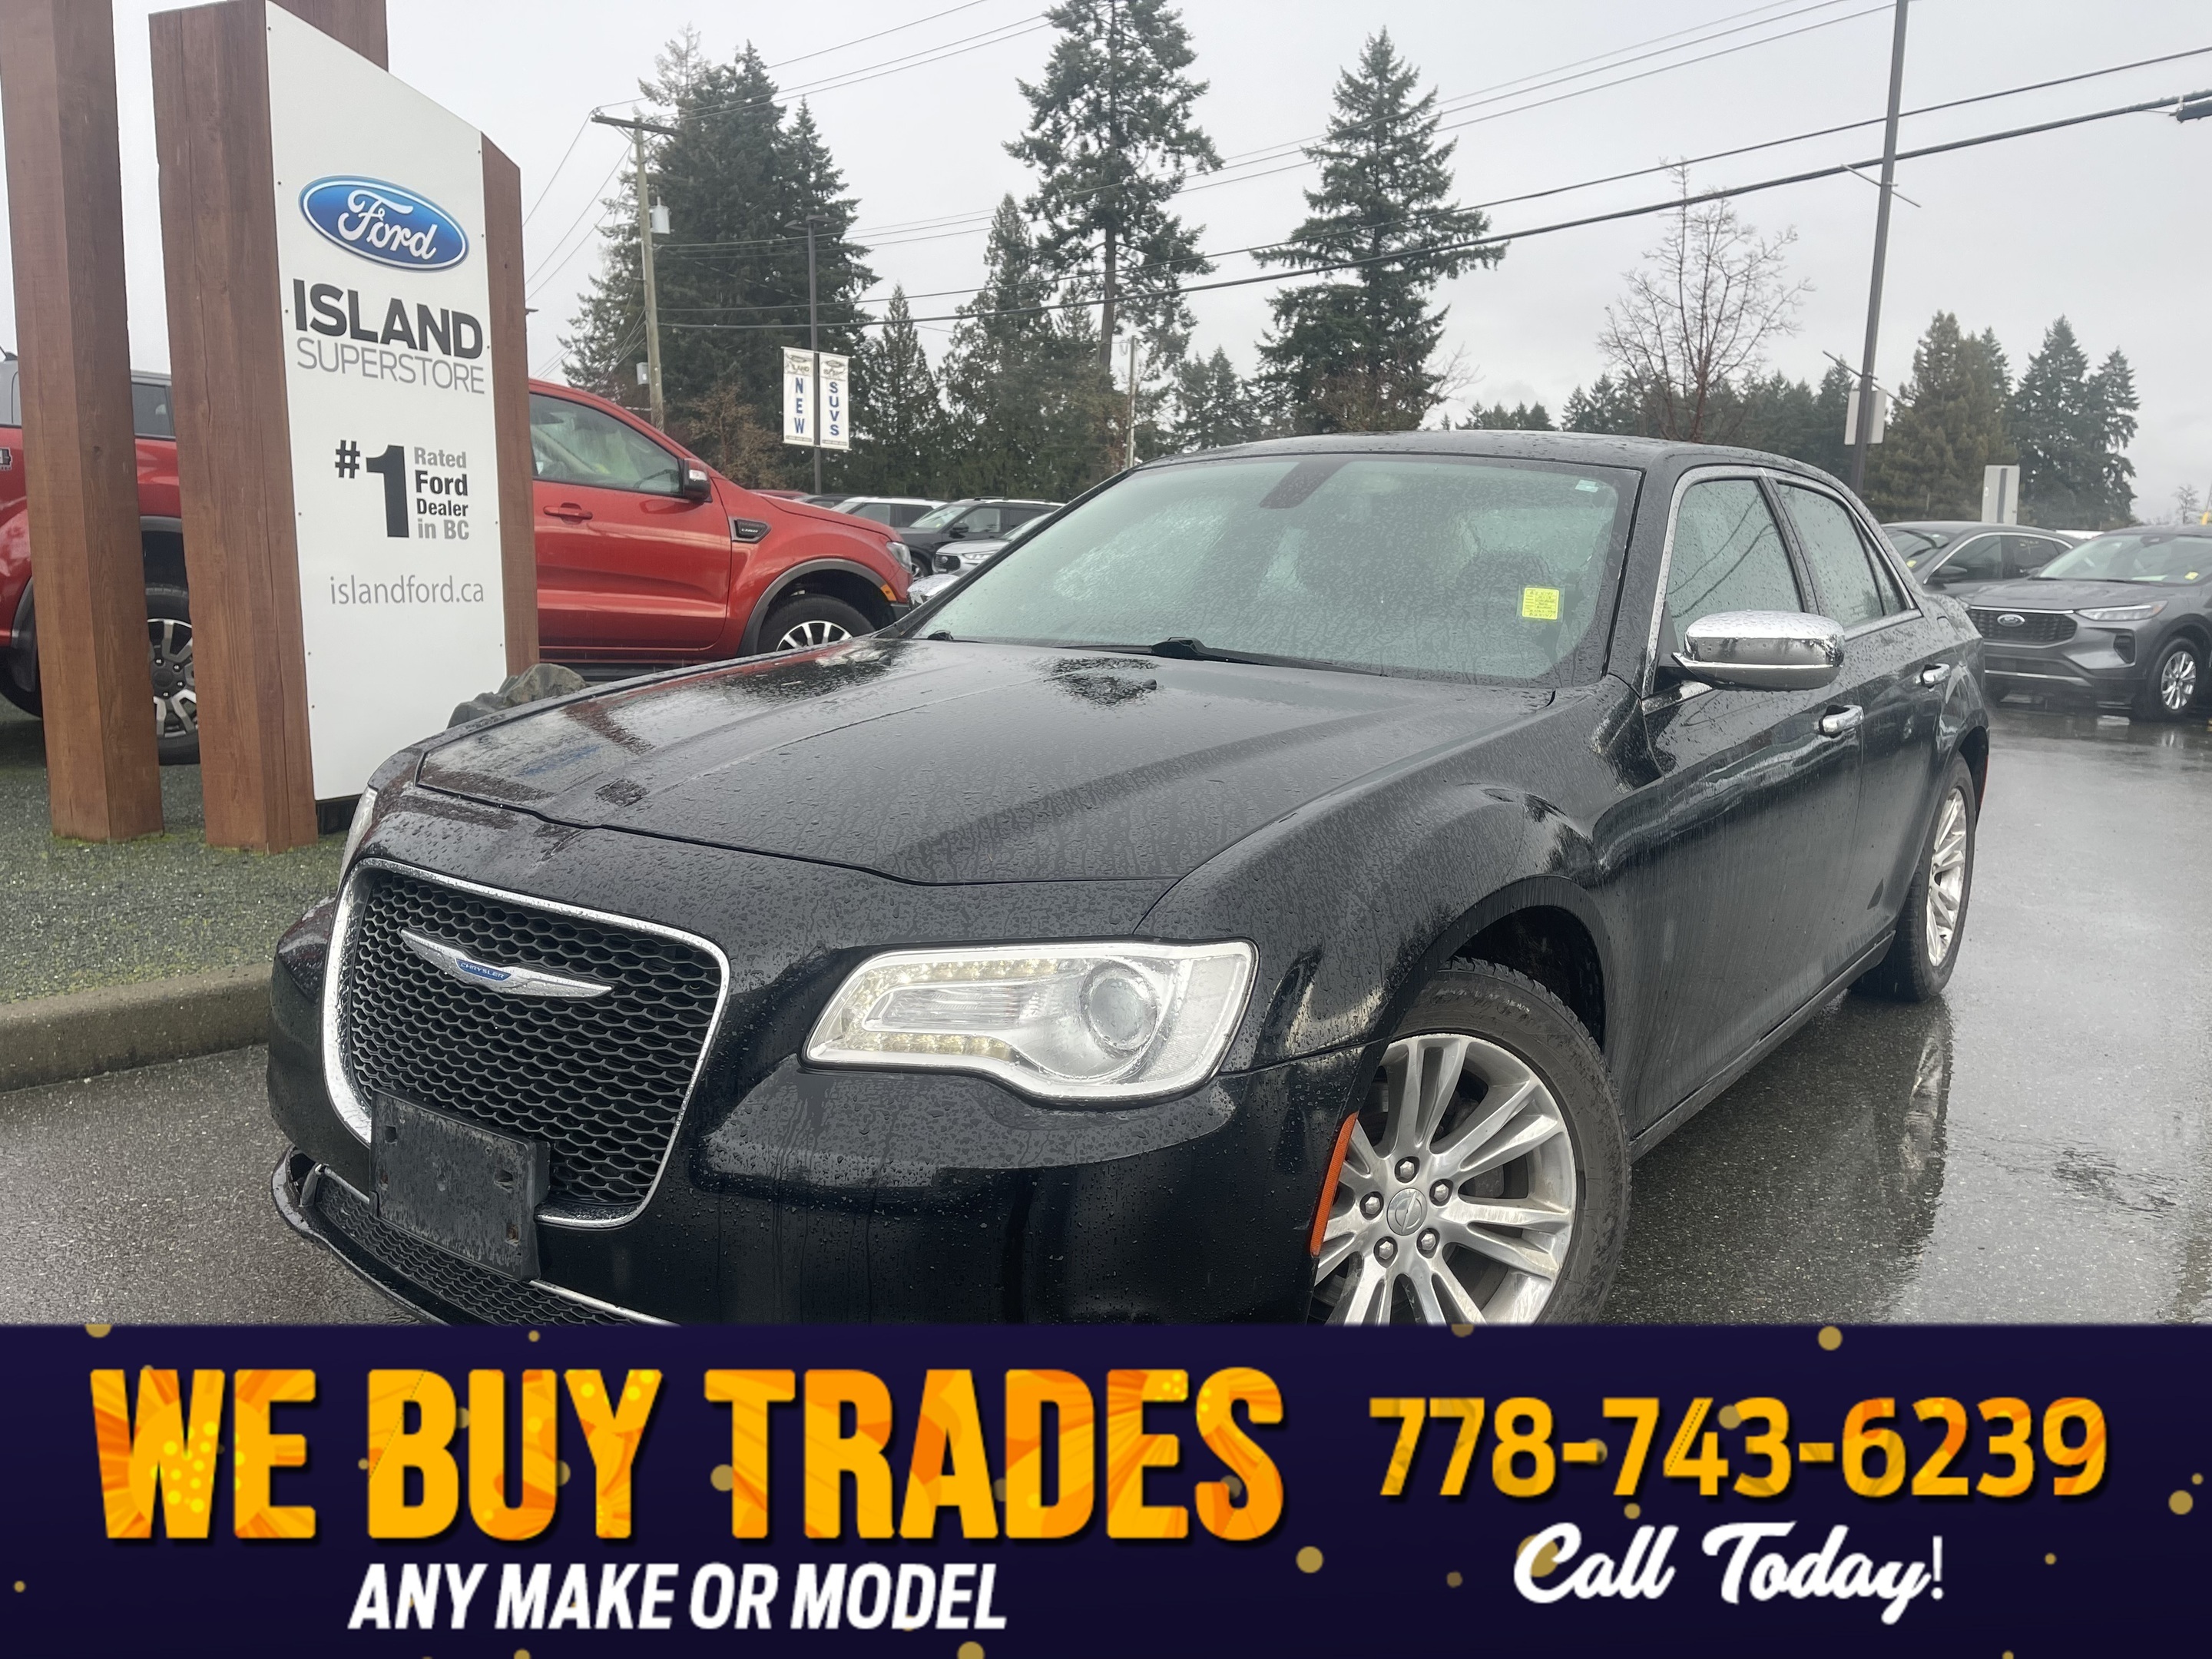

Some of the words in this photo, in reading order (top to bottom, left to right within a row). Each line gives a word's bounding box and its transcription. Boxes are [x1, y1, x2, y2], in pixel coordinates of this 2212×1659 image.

[338, 189, 437, 260] Ford
[293, 278, 483, 359] ISLAND
[296, 336, 485, 394] SUPERSTORE
[794, 377, 805, 435] NEW
[829, 381, 839, 436] SUVS
[413, 446, 467, 469] Rated
[335, 439, 409, 538] #1
[415, 469, 469, 496] Ford
[416, 498, 469, 517] Dealer
[418, 518, 436, 539] in
[443, 519, 469, 540] BC
[329, 575, 484, 604] islandford.ca
[461, 962, 505, 979] CHRYSLER
